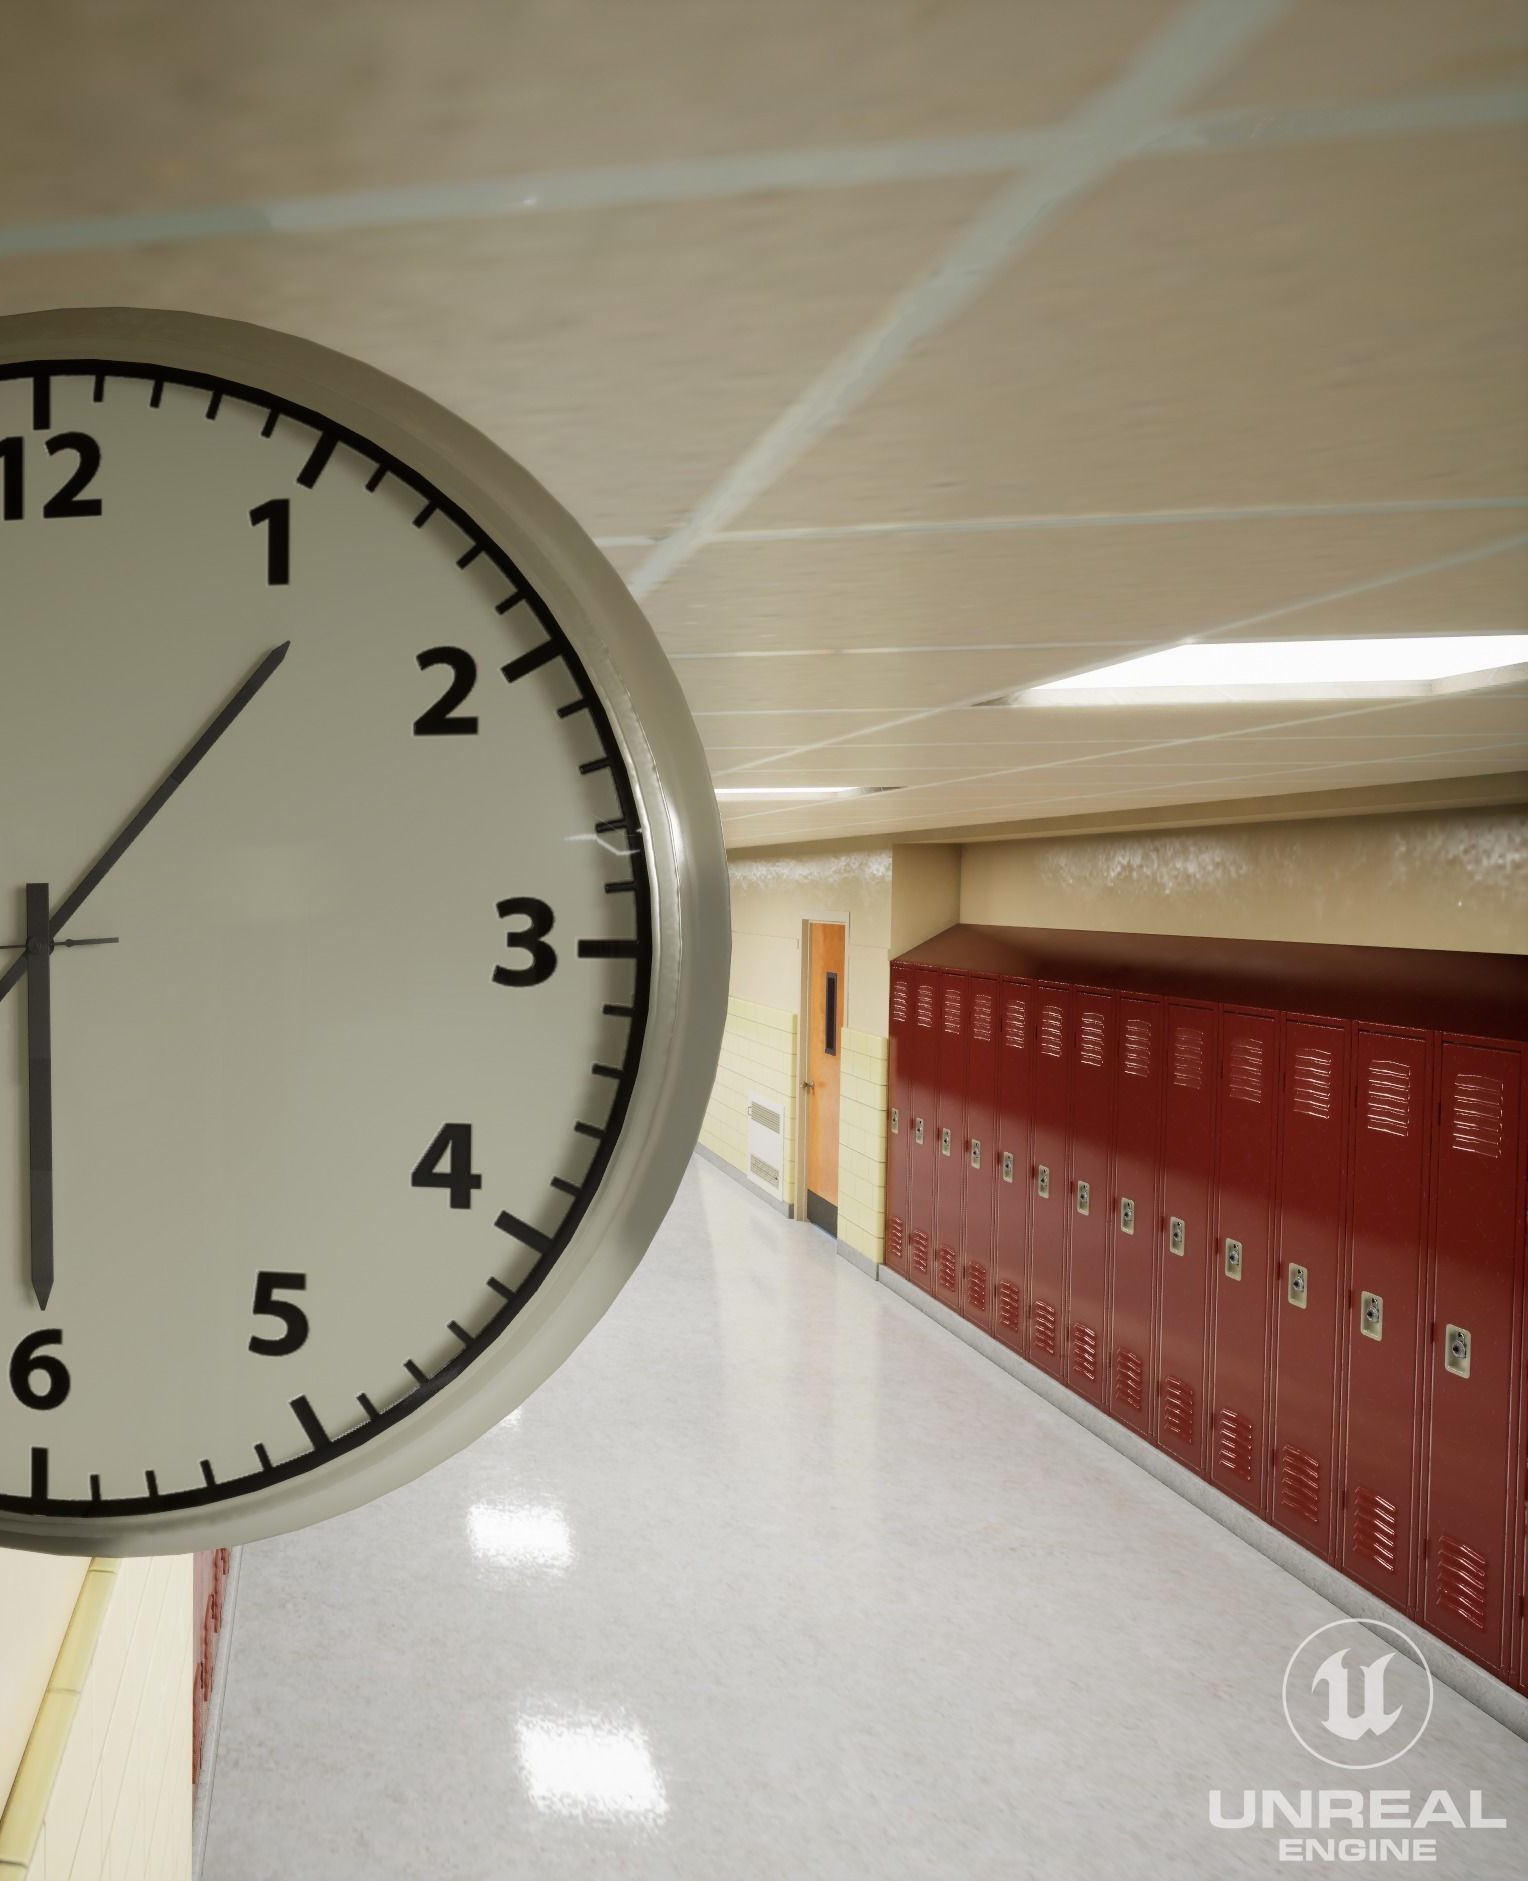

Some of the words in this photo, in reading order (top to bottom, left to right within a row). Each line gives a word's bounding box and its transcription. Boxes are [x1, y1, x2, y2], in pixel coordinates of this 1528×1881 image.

[249, 498, 291, 586] 1
[413, 645, 479, 736] 2
[491, 896, 558, 988] 3
[410, 1122, 483, 1211] 4
[247, 1270, 310, 1358] 5
[8, 1327, 72, 1412] 6
